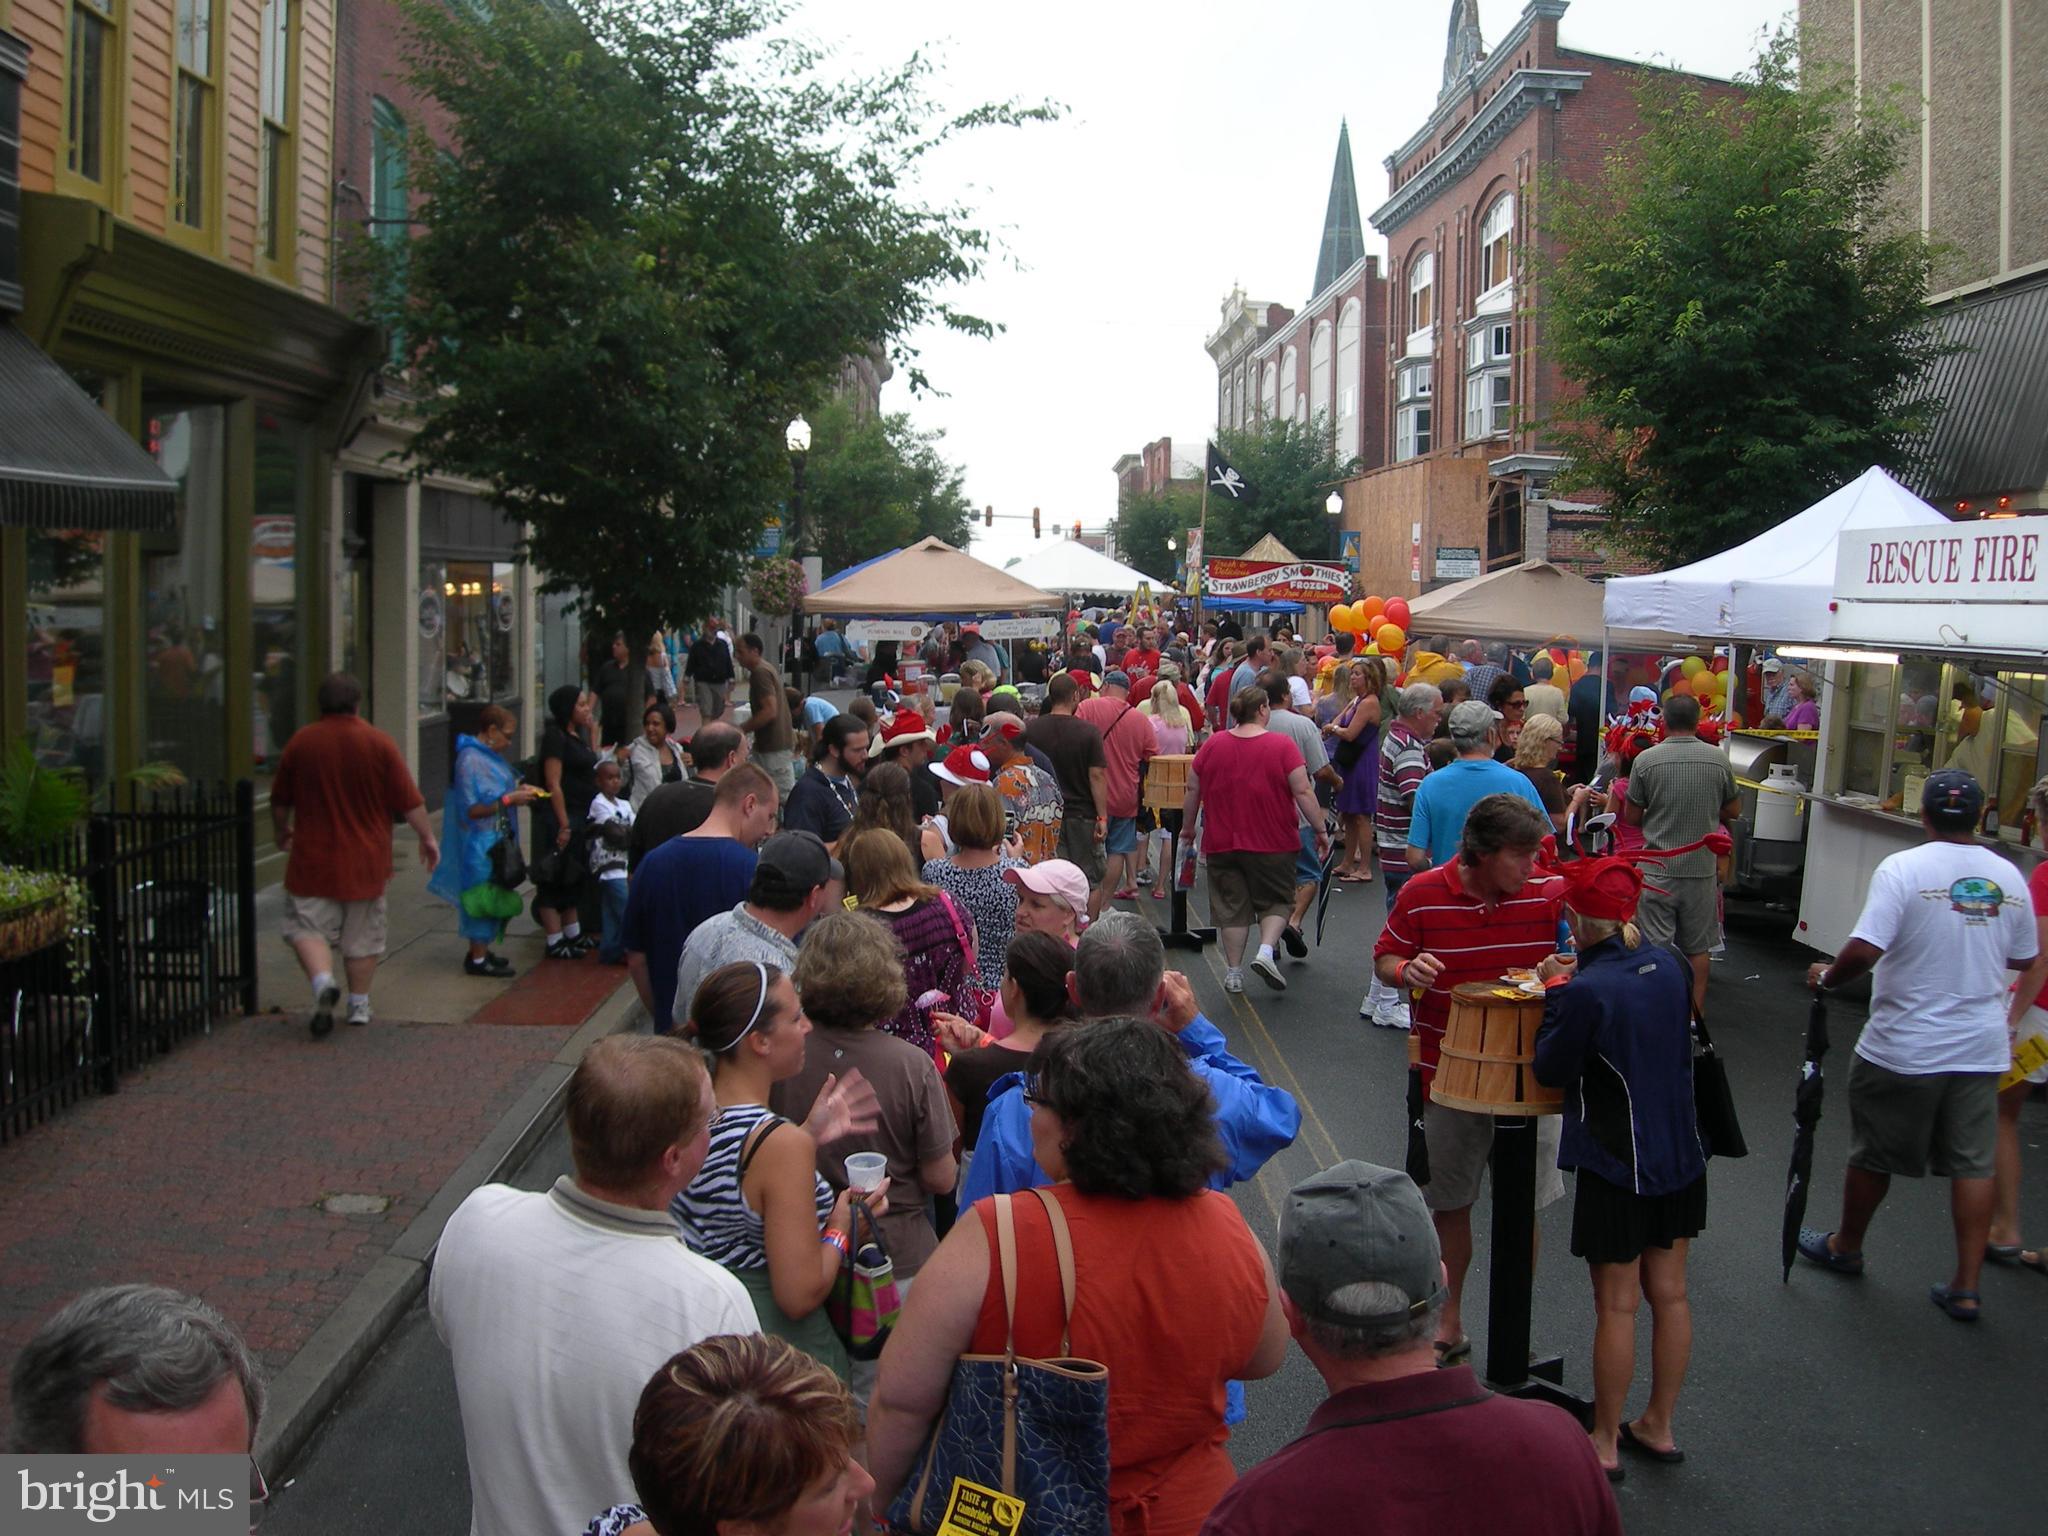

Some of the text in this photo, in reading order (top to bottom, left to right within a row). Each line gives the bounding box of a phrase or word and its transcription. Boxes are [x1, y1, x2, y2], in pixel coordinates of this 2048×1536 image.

[1866, 534, 2039, 584] RESCUE FIRE
[1212, 569, 1280, 593] STRAWBERRY
[1290, 580, 1329, 591] FROZEN
[961, 1489, 981, 1506] TASTE
[957, 1501, 992, 1524] Cambridge
